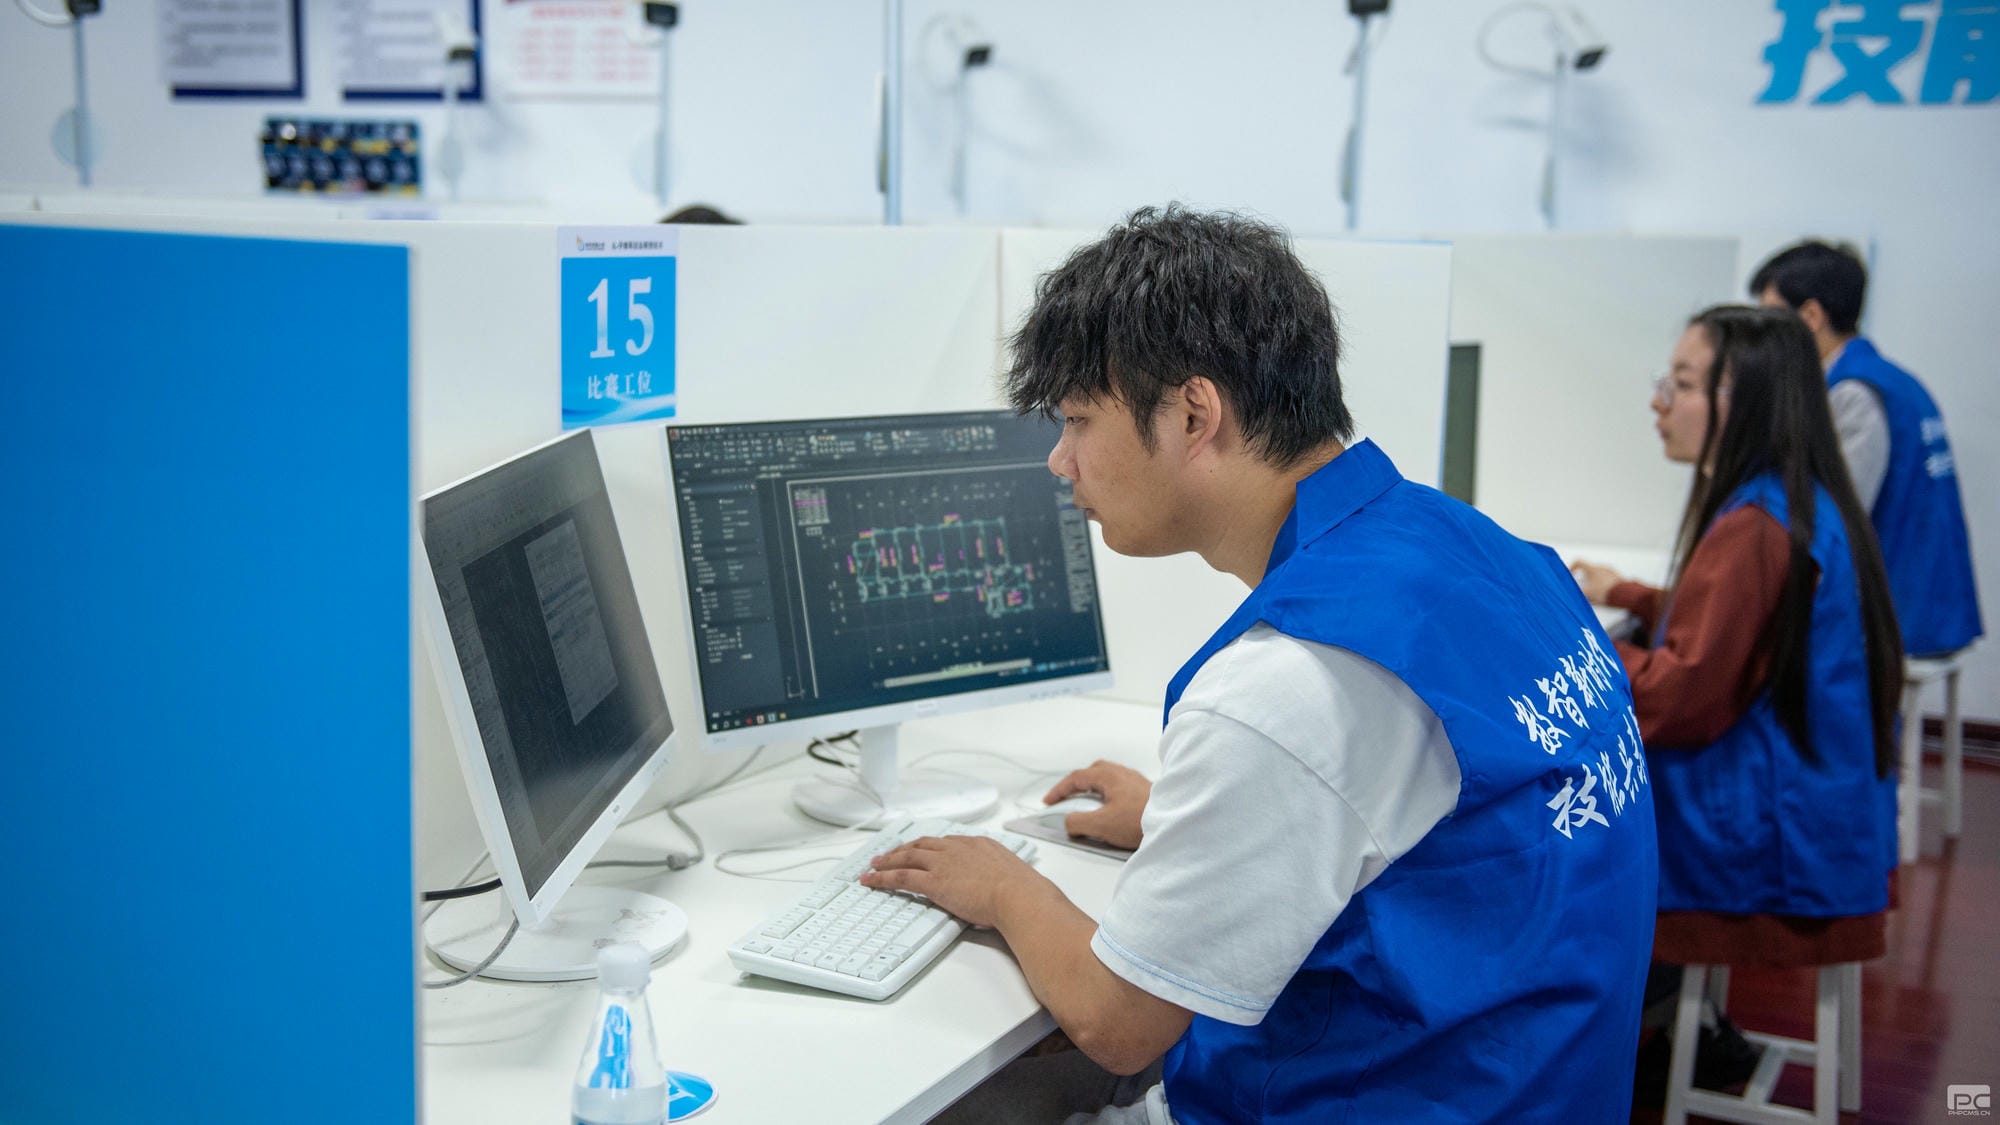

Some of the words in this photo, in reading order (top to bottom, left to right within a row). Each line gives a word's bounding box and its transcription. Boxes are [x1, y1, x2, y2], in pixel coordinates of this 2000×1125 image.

[587, 276, 655, 359] 15
[587, 371, 651, 400] 比赛工位
